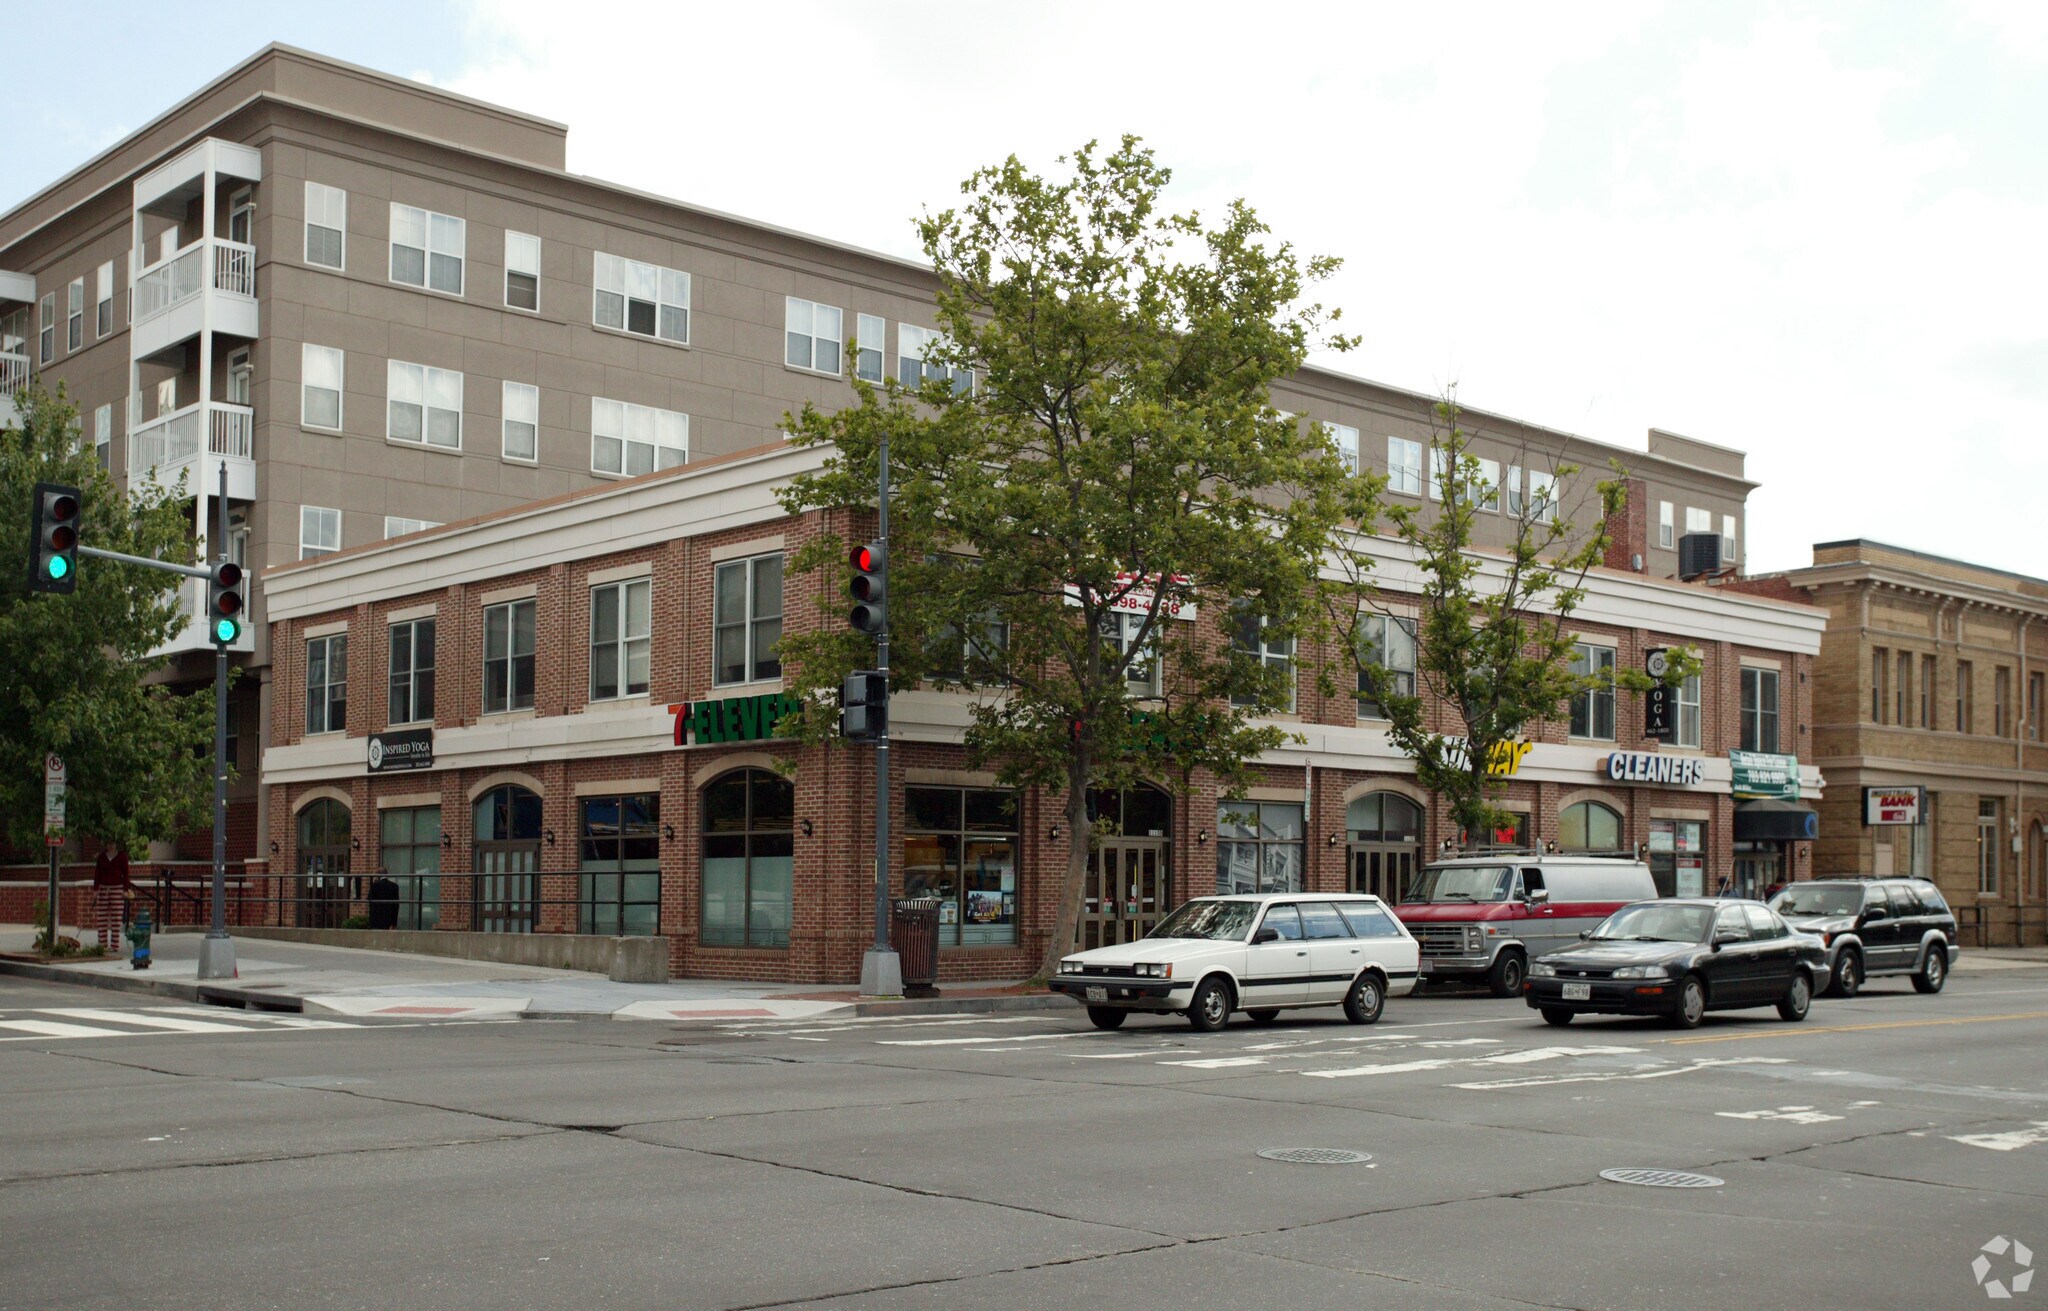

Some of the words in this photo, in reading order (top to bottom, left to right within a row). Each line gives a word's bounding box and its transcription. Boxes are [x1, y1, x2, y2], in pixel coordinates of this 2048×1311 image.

[382, 744, 410, 755] INSPIRED
[411, 741, 430, 752] YOGA
[1608, 753, 1704, 785] CLEANERS
[1880, 796, 1915, 806] BANK
